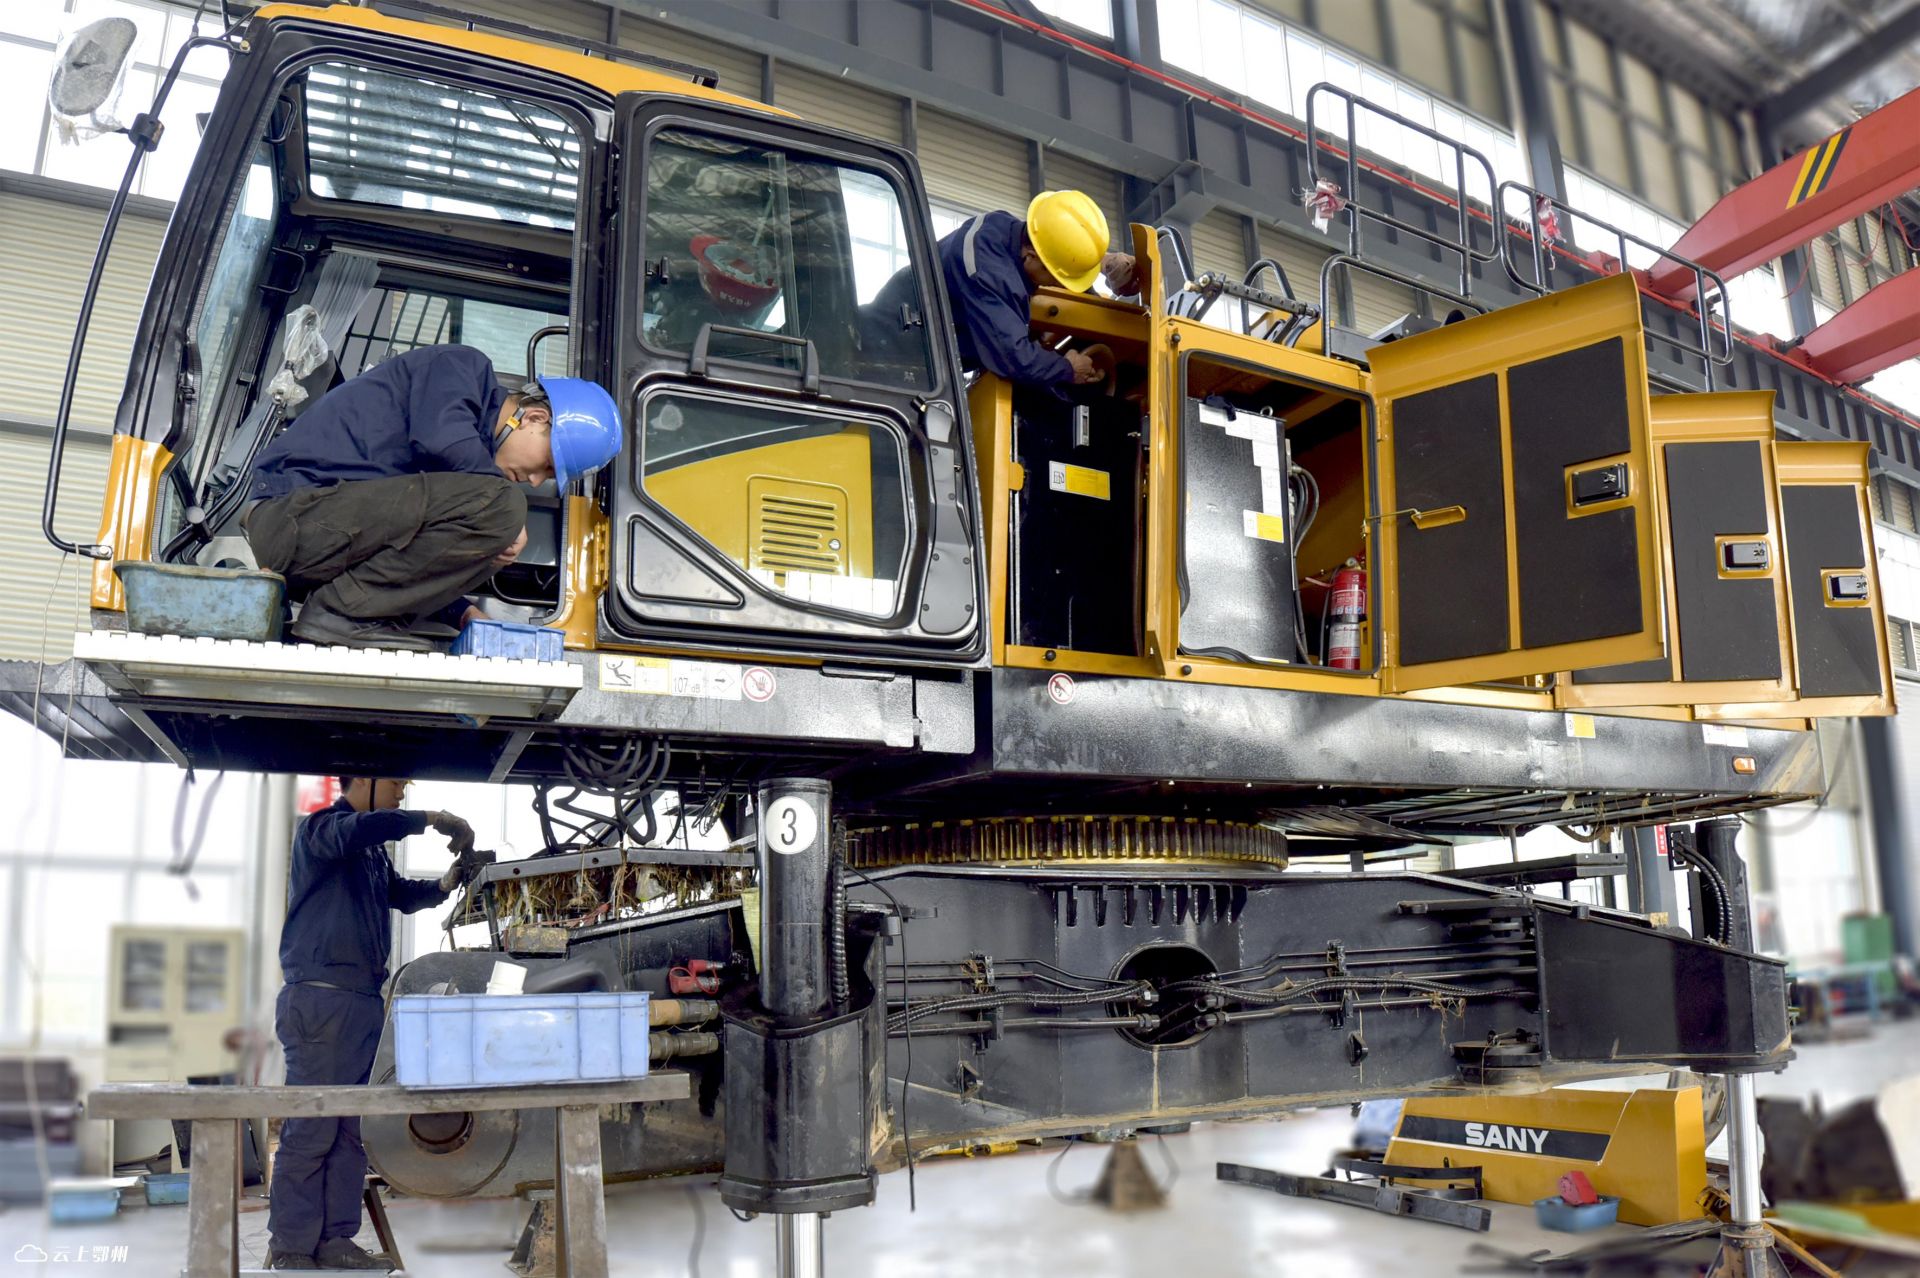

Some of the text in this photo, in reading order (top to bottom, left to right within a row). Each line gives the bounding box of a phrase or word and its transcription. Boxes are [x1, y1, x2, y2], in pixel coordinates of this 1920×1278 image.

[673, 676, 689, 693] 107
[781, 807, 797, 846] 3
[1465, 1122, 1549, 1154] SANY
